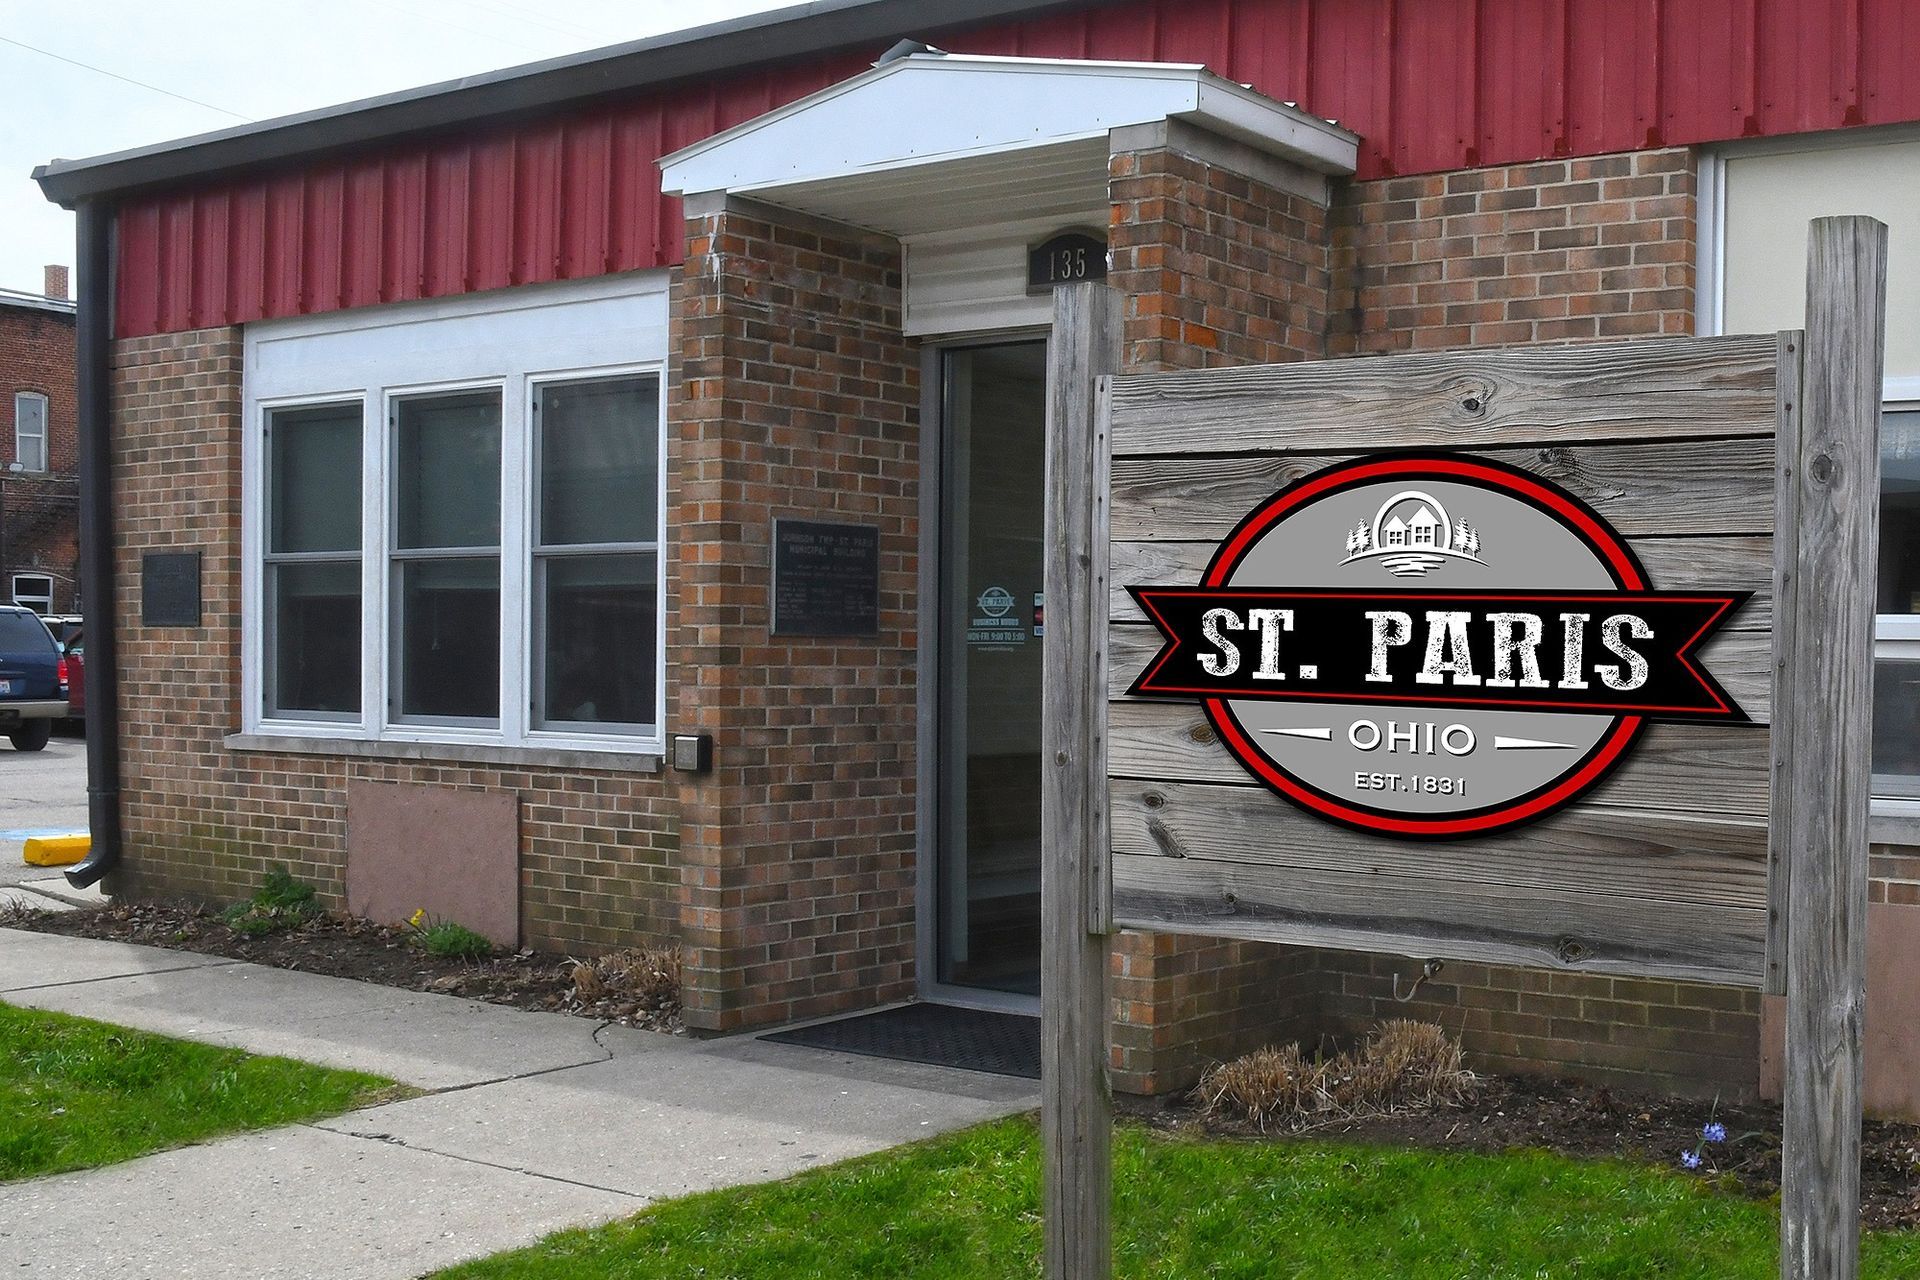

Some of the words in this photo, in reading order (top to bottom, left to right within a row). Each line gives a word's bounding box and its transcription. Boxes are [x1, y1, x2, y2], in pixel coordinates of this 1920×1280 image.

[1050, 248, 1086, 280] 135
[790, 544, 828, 556] MUNICIPAL
[992, 597, 1010, 606] PARIS
[973, 618, 999, 626] BUSINESS
[1197, 608, 1317, 680] ST.
[1365, 610, 1654, 691] PARIS
[1348, 719, 1476, 756] OHIO
